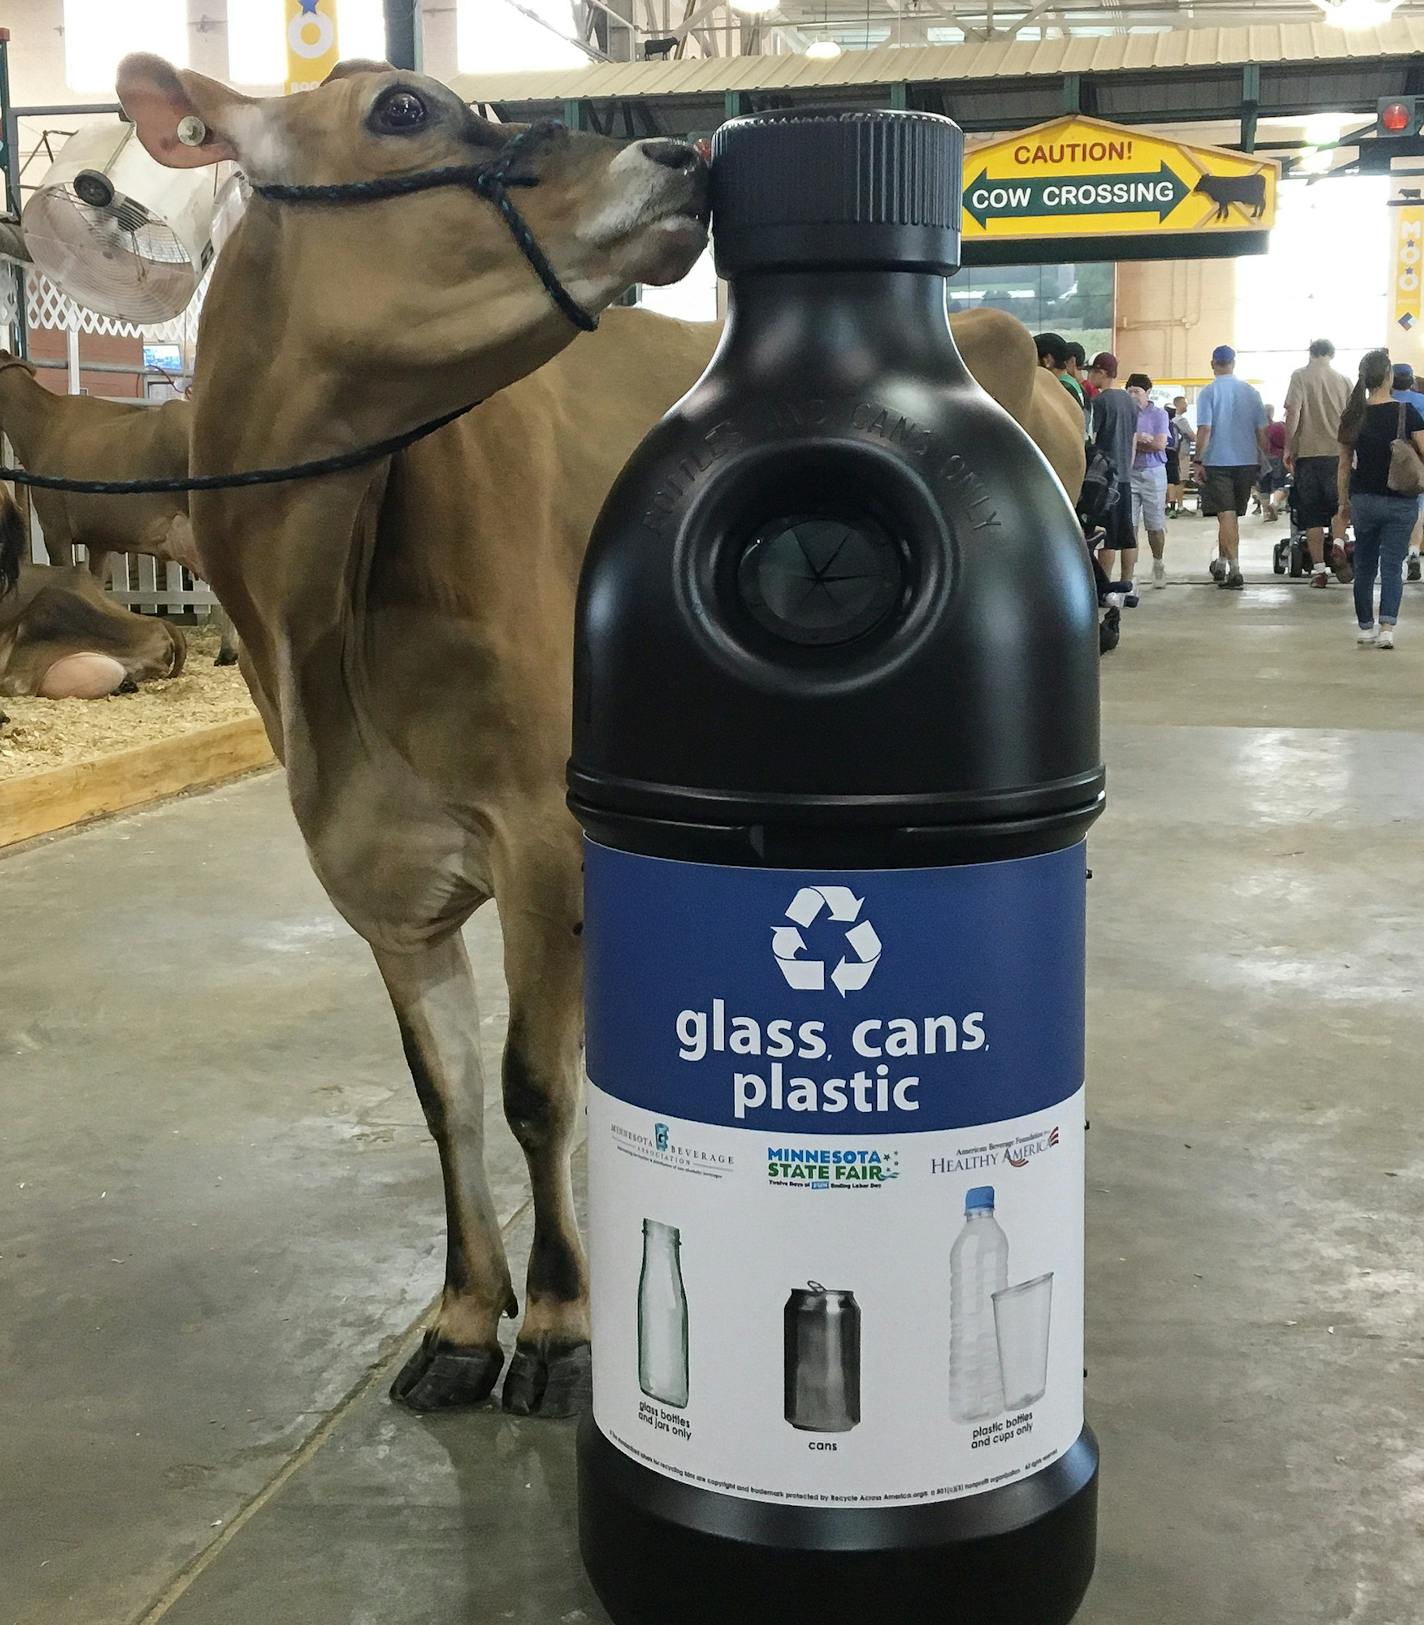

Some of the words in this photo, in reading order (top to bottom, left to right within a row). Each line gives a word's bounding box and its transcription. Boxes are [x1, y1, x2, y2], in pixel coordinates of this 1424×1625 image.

[1014, 141, 1133, 165] CAUTION!
[972, 187, 1032, 210] COW
[1042, 181, 1174, 206] CROSSING
[675, 998, 833, 1062] glass,
[851, 1011, 990, 1058] cans,
[733, 1062, 920, 1119] plastic
[610, 1123, 653, 1147] MINNESOTA
[671, 1145, 735, 1165] BEVERAGE
[768, 1147, 882, 1164] MINNESOTA
[768, 1162, 830, 1179] STATE
[835, 1165, 884, 1181] FAIR
[638, 1411, 653, 1426] and
[654, 1417, 670, 1432] jars
[672, 1425, 692, 1441] only
[639, 1401, 659, 1417] glass
[660, 1408, 691, 1428] bottles
[972, 1421, 1003, 1440] plastic
[1006, 1411, 1033, 1429] bottles
[808, 1441, 838, 1451] cans
[971, 1435, 991, 1449] and
[993, 1428, 1015, 1445] cups
[1016, 1422, 1034, 1436] only
